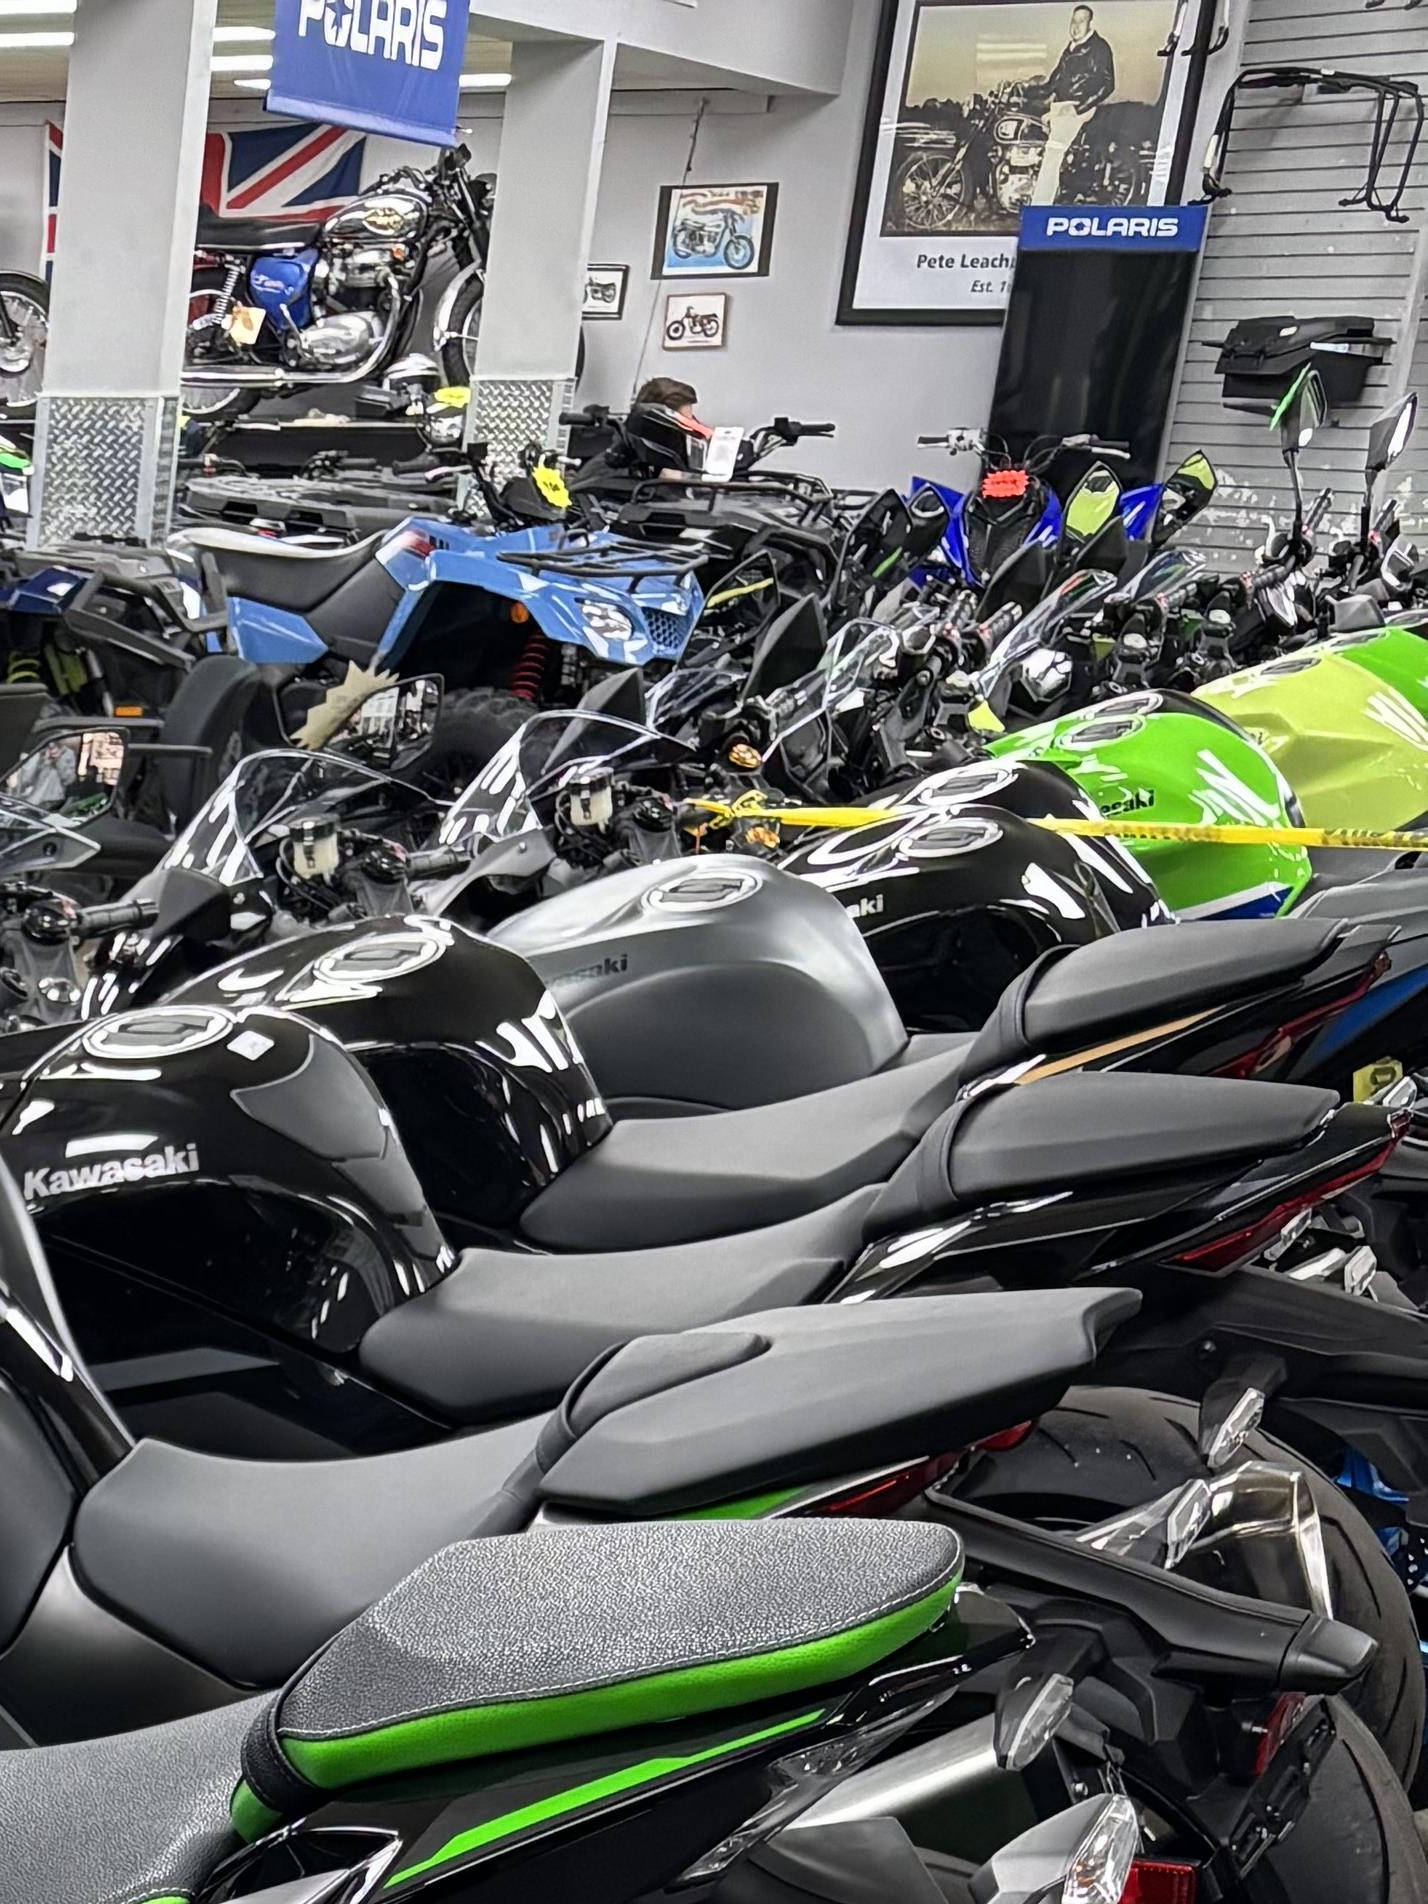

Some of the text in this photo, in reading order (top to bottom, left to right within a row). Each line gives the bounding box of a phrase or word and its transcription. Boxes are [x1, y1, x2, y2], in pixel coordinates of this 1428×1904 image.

[298, 0, 447, 71] POLARIS
[1047, 217, 1179, 237] POLARIS
[916, 254, 955, 269] Pete
[971, 280, 994, 293] Est.
[24, 1142, 200, 1201] Kawasaki
